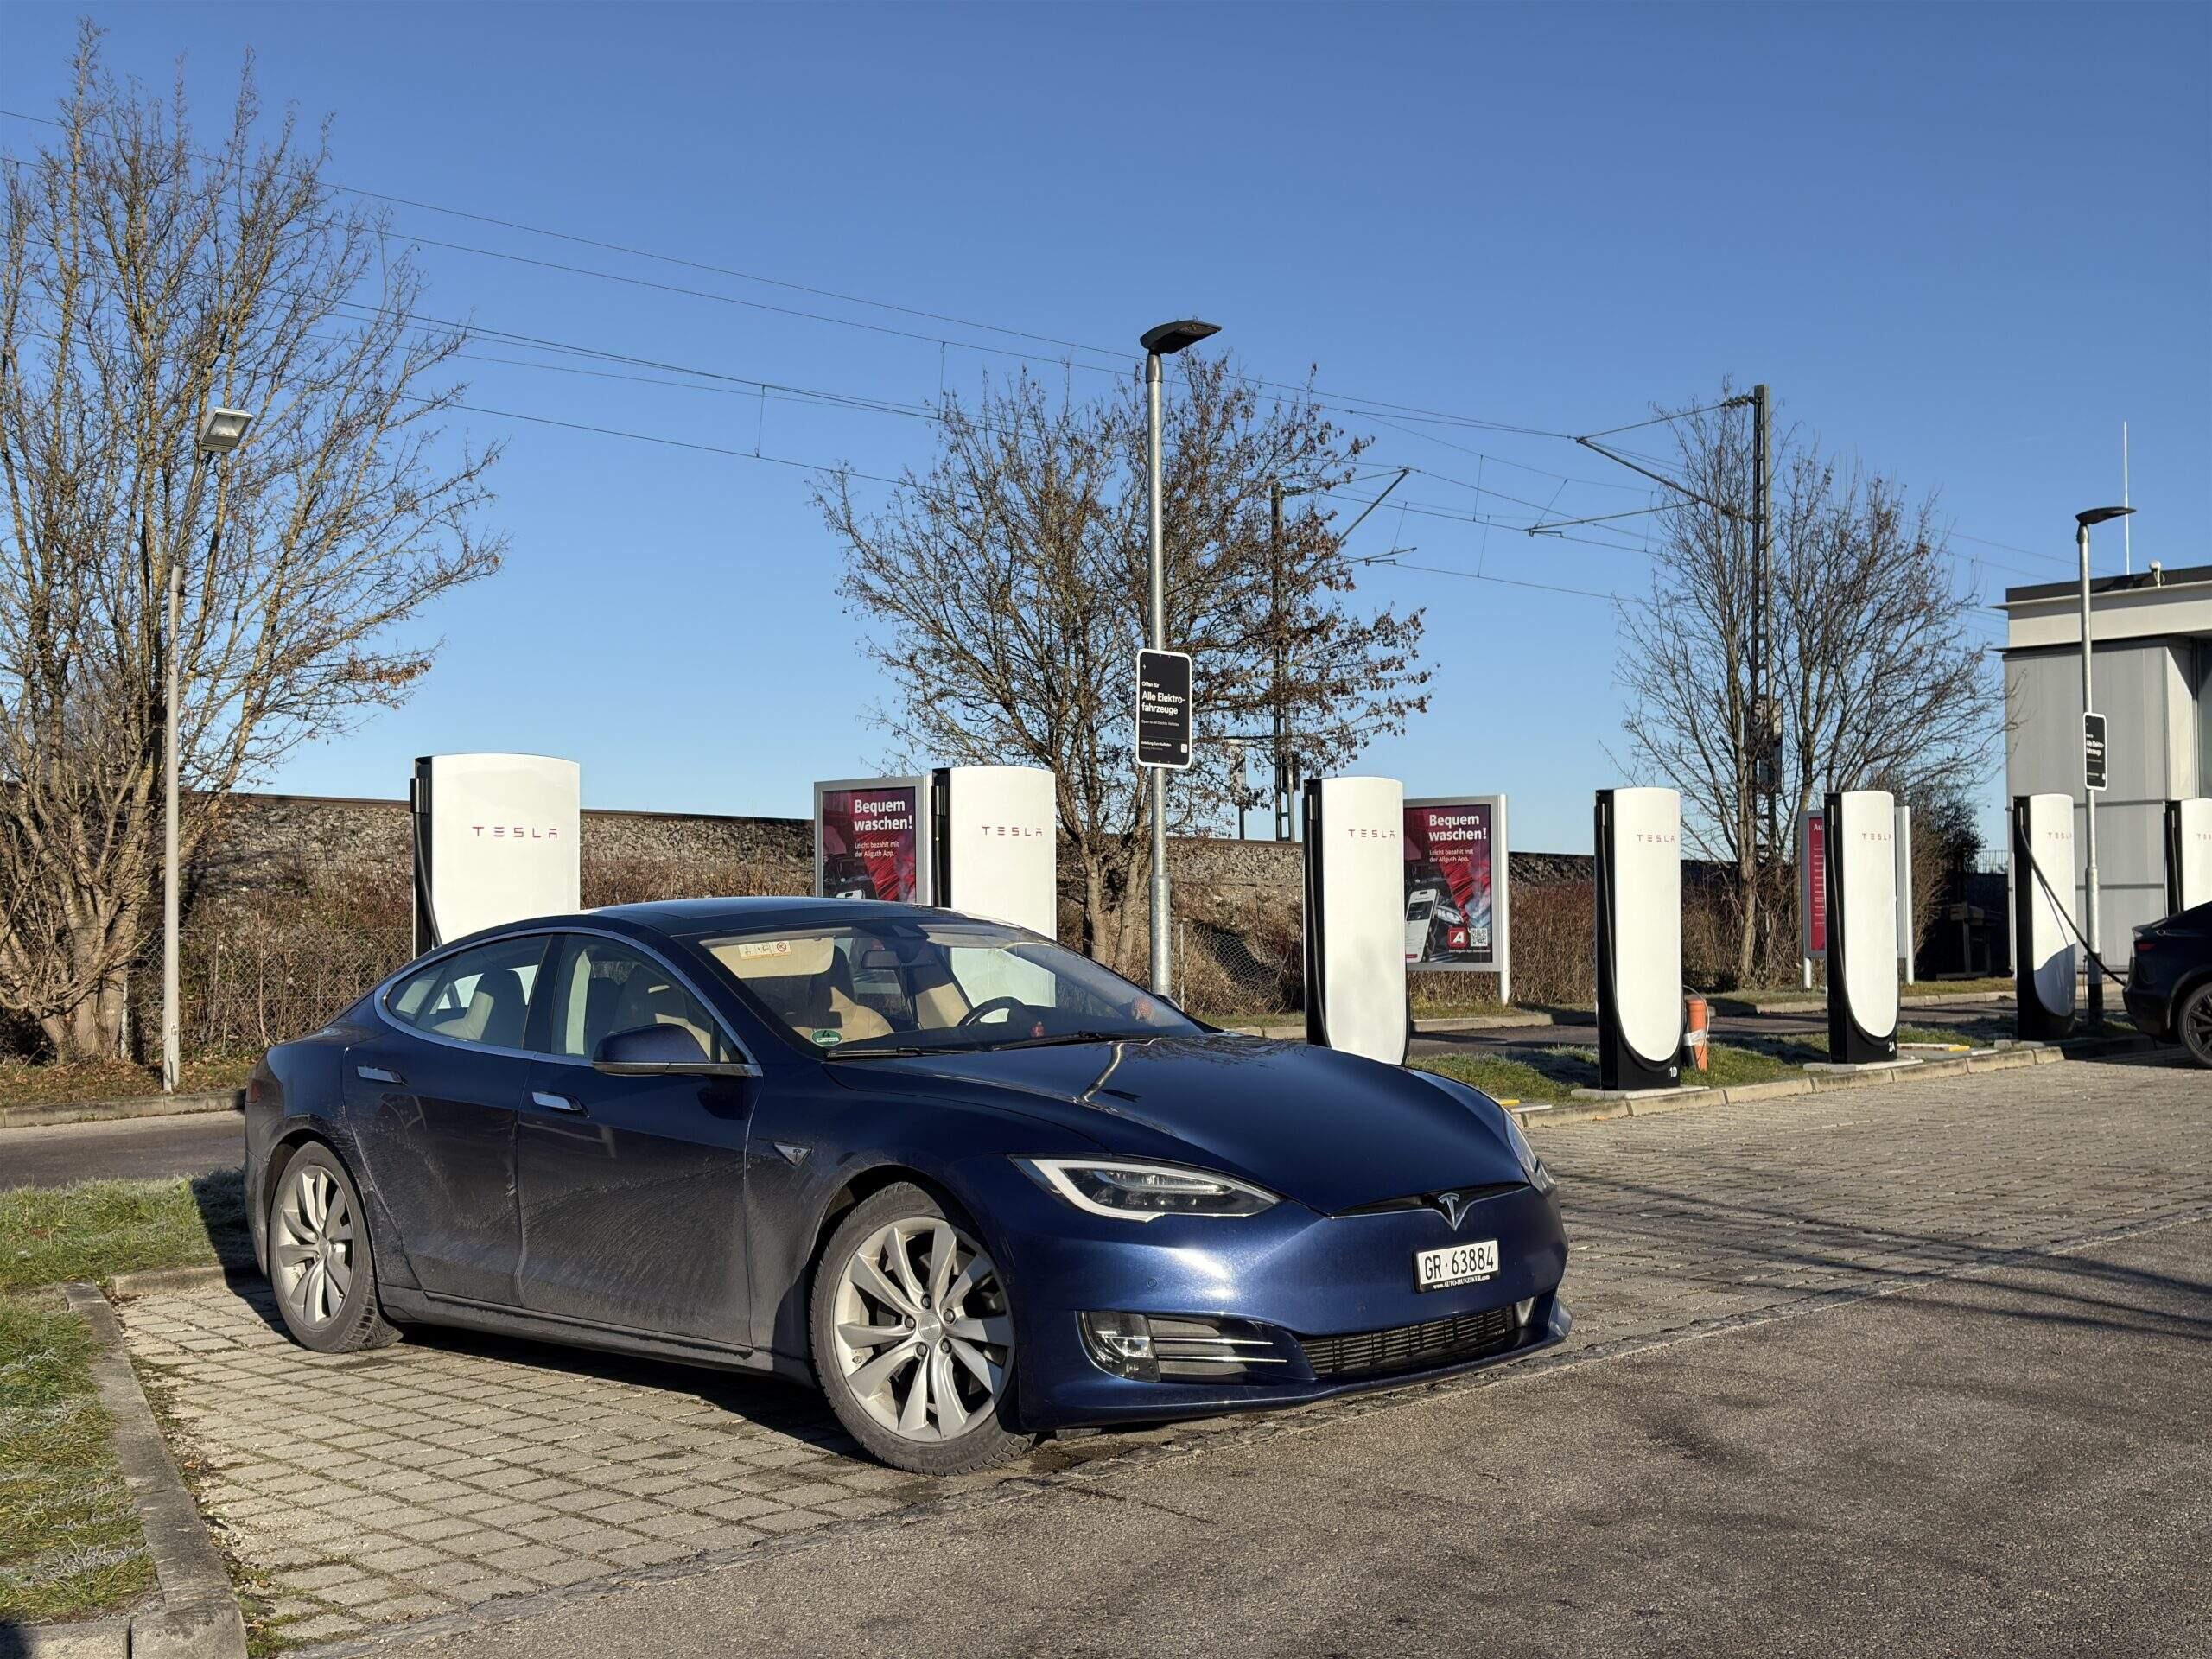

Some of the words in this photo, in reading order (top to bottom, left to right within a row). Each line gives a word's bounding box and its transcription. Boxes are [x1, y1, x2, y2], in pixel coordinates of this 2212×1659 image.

[1141, 690, 1156, 701] Alle
[1158, 692, 1186, 703] Elektro-
[1141, 702, 1178, 715] fahrzeuge
[855, 799, 905, 816] Bequem
[854, 815, 912, 831] waschen!
[1429, 814, 1479, 829] Bequem
[472, 826, 557, 839] TESLA
[982, 826, 1042, 836] TESLA
[1348, 830, 1395, 838] TESLA
[1428, 827, 1487, 841] waschen!
[1637, 834, 1675, 843] TESLA
[1669, 1066, 1678, 1077] 1D
[1425, 1255, 1441, 1280] GR
[1452, 1246, 1493, 1275] 63884
[1433, 1275, 1490, 1289] www.AUTO-HUNZIKER.com
